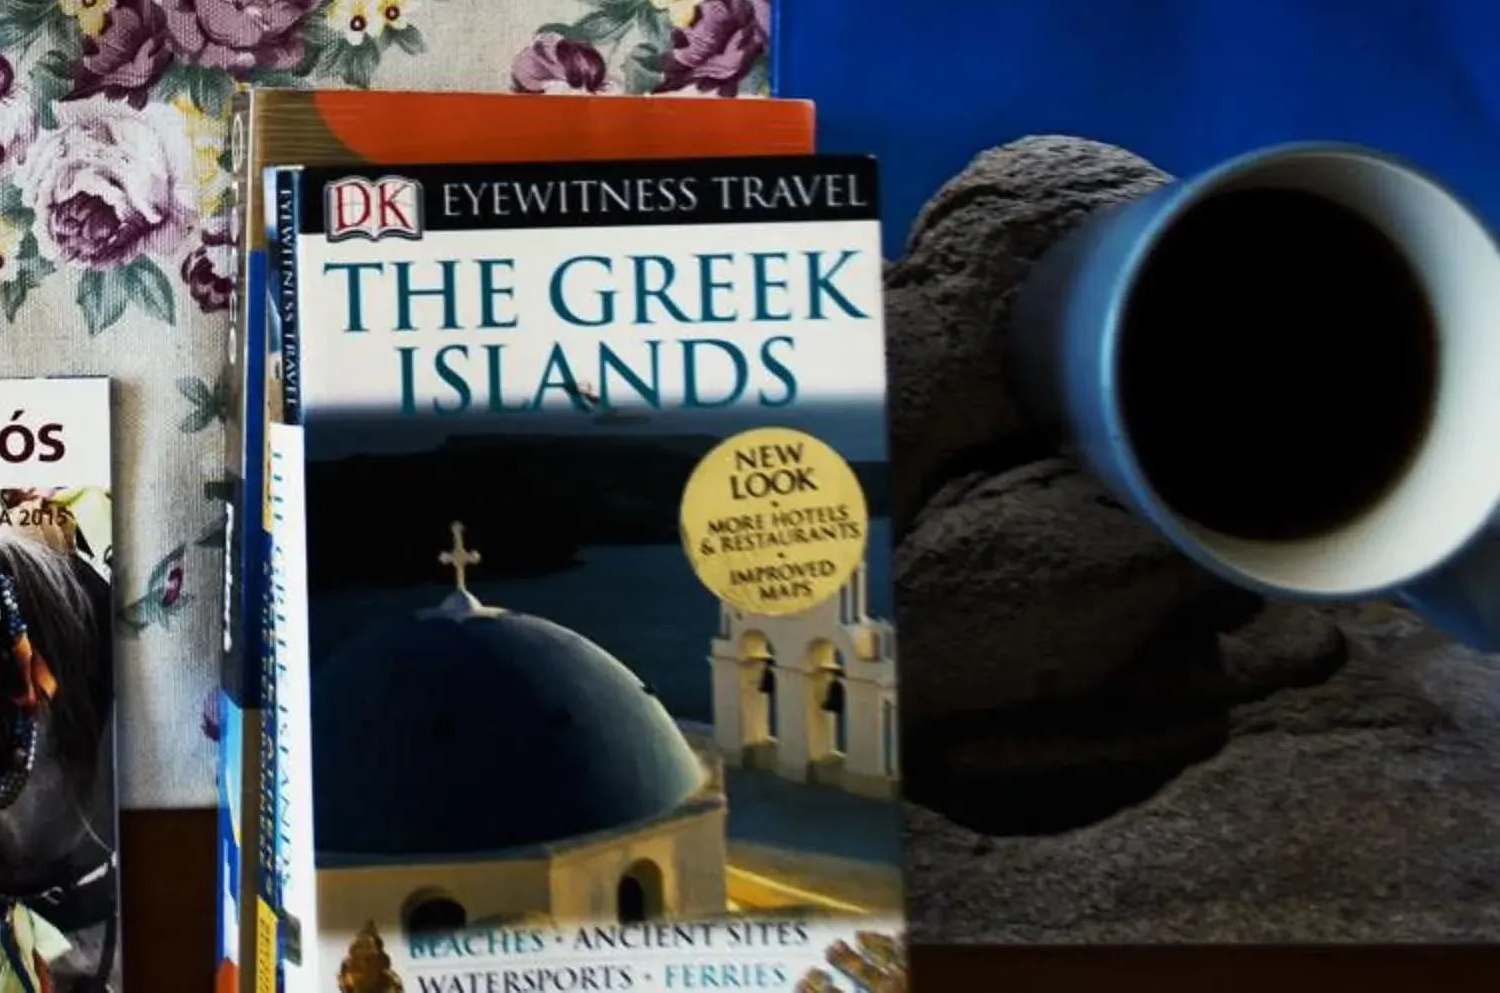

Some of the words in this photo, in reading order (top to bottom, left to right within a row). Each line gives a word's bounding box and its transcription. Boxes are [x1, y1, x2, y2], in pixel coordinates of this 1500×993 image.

[333, 179, 418, 230] DK
[442, 177, 698, 218] EYEWITNESS
[711, 174, 869, 210] TRAVEL
[323, 257, 520, 334] THE
[548, 250, 872, 328] GREEK
[397, 335, 799, 418] ISLANDS
[734, 442, 805, 472] NEW
[729, 466, 820, 500] LOOK
[19, 508, 69, 527] 2015
[708, 514, 764, 534] MORE
[771, 504, 850, 527] HOTELS
[701, 537, 716, 556] &
[720, 520, 862, 554] RESTAURANTS
[729, 559, 837, 586] IMPROVED
[758, 581, 813, 602] MAPS
[408, 928, 546, 959] BEACHES
[572, 922, 716, 951] ANCIENT
[726, 920, 811, 949] SITES
[416, 963, 634, 993] WATERSPORTS
[664, 962, 788, 990] FERRIES
